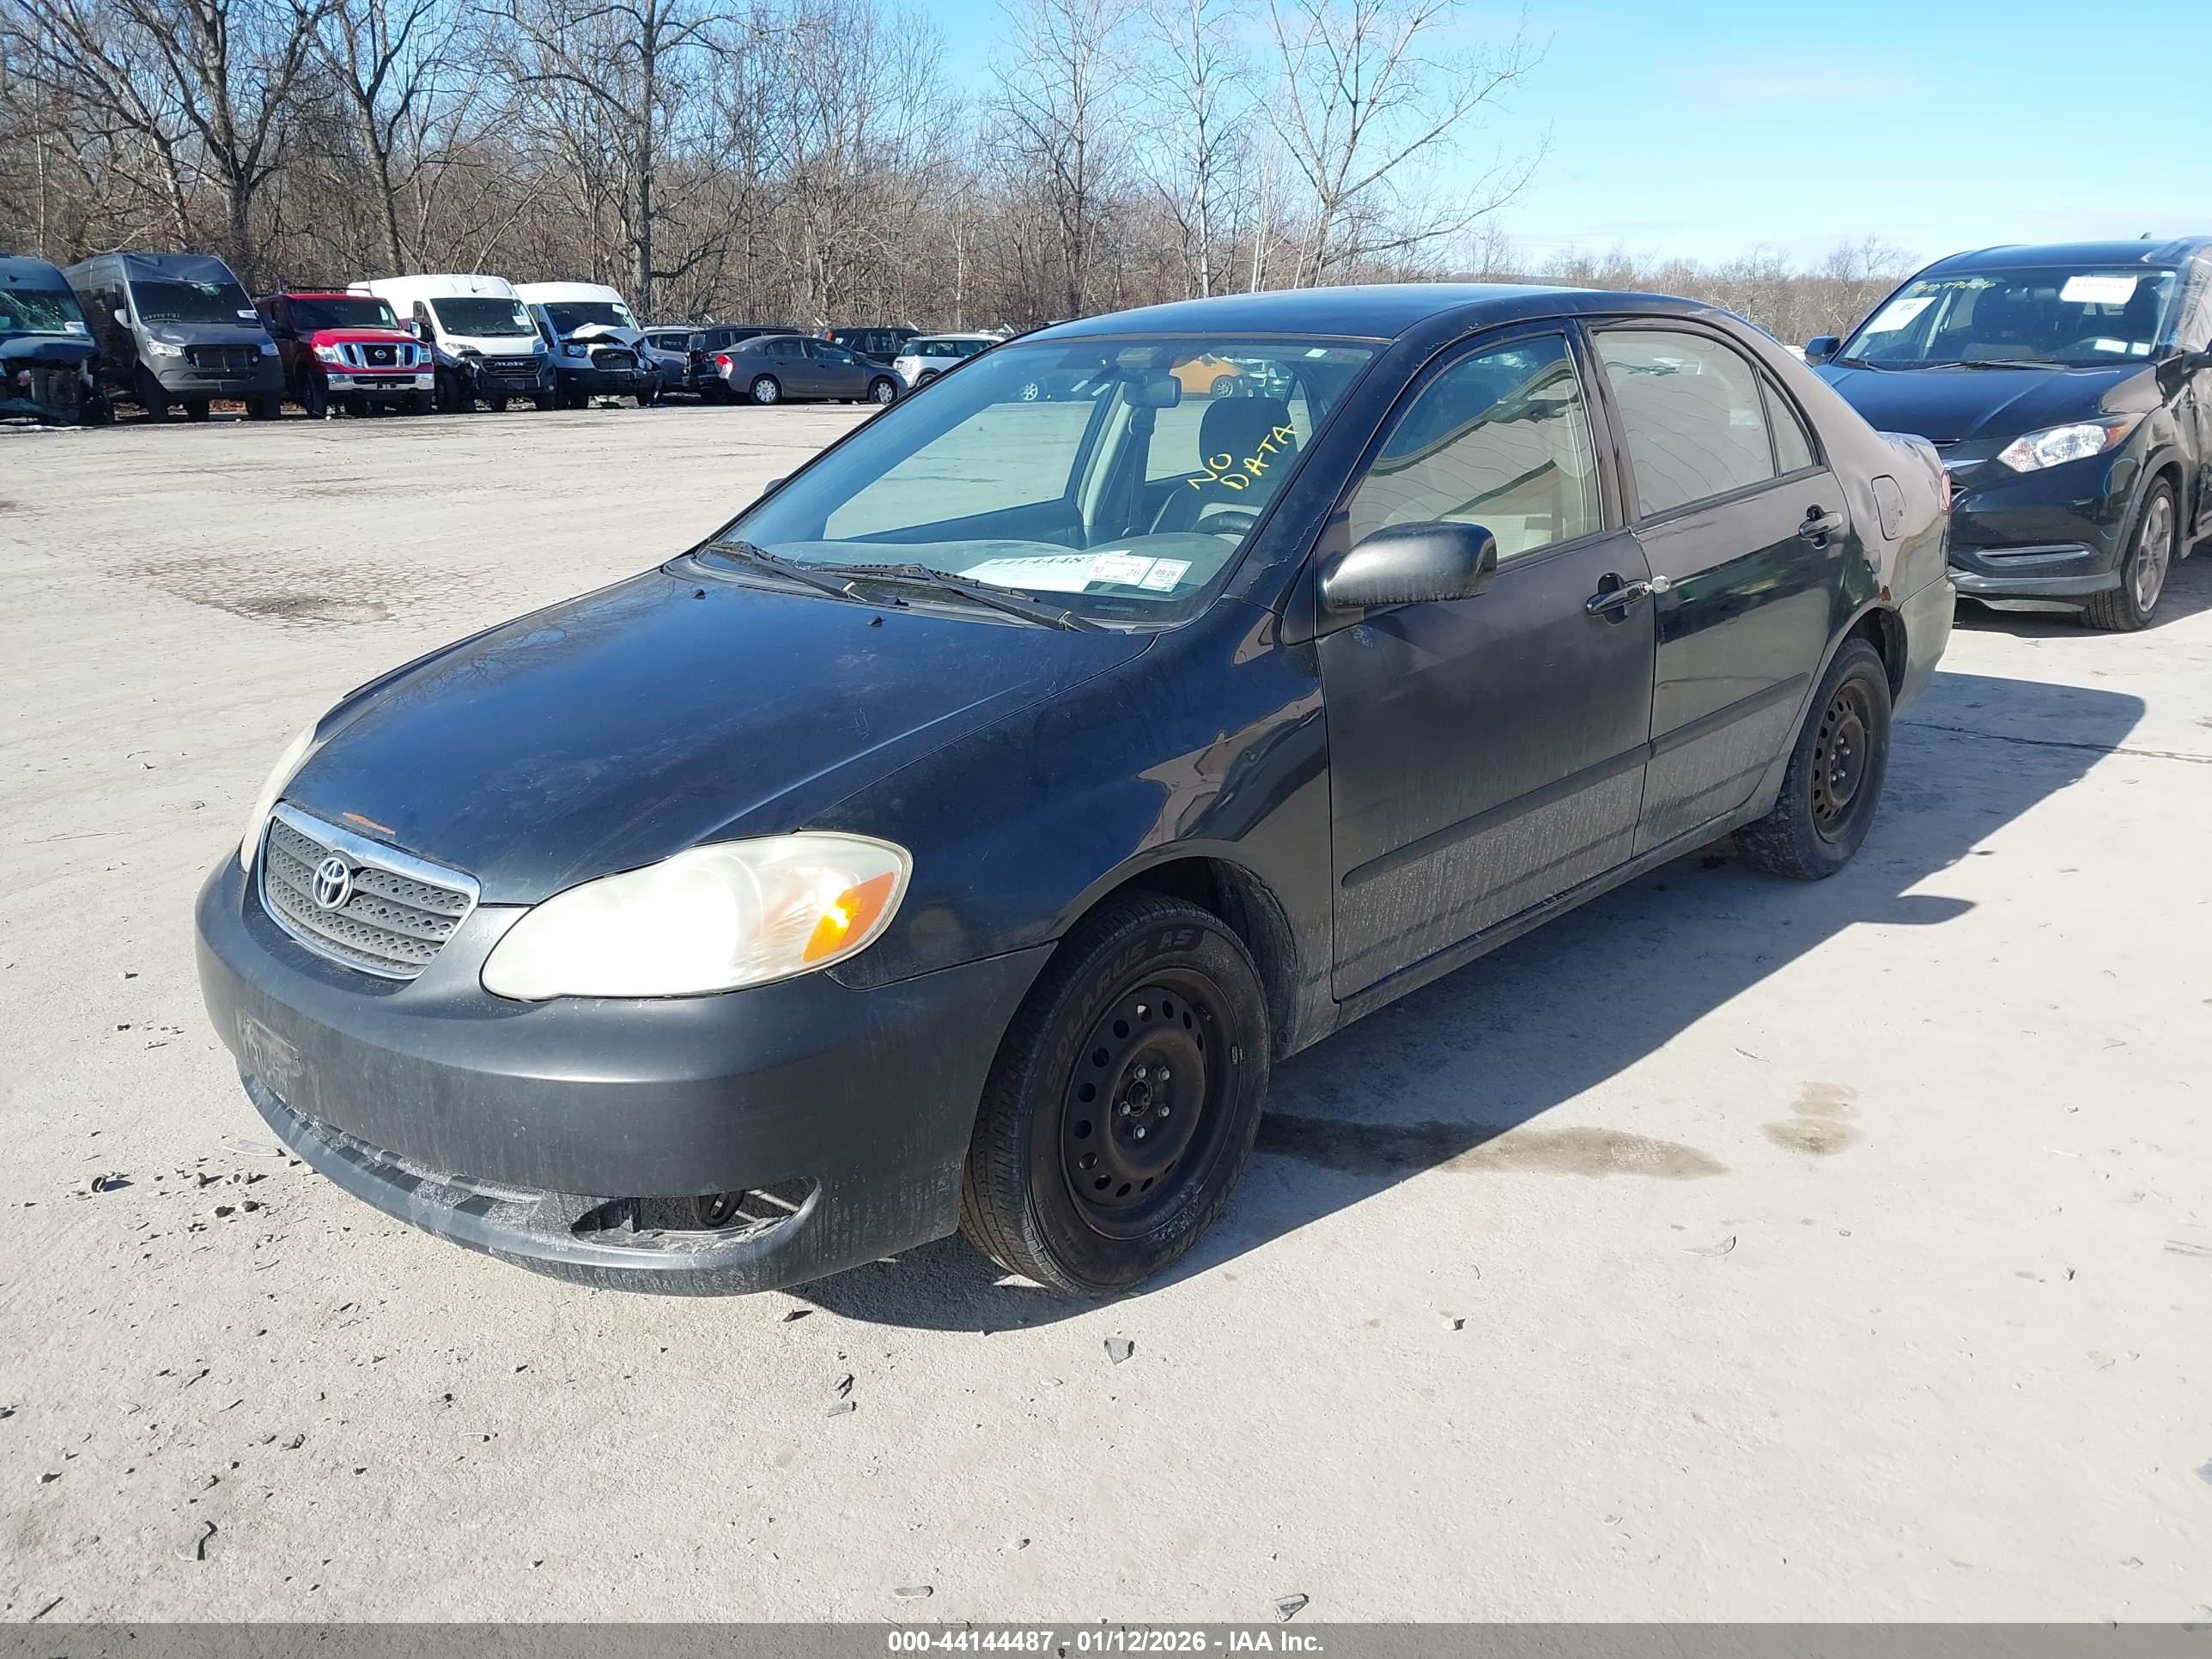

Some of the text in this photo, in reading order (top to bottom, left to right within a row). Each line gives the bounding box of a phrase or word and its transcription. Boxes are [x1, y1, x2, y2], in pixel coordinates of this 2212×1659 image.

[1187, 453, 1232, 490] NO
[1219, 423, 1299, 490] DATA
[1158, 928, 1195, 950] AS
